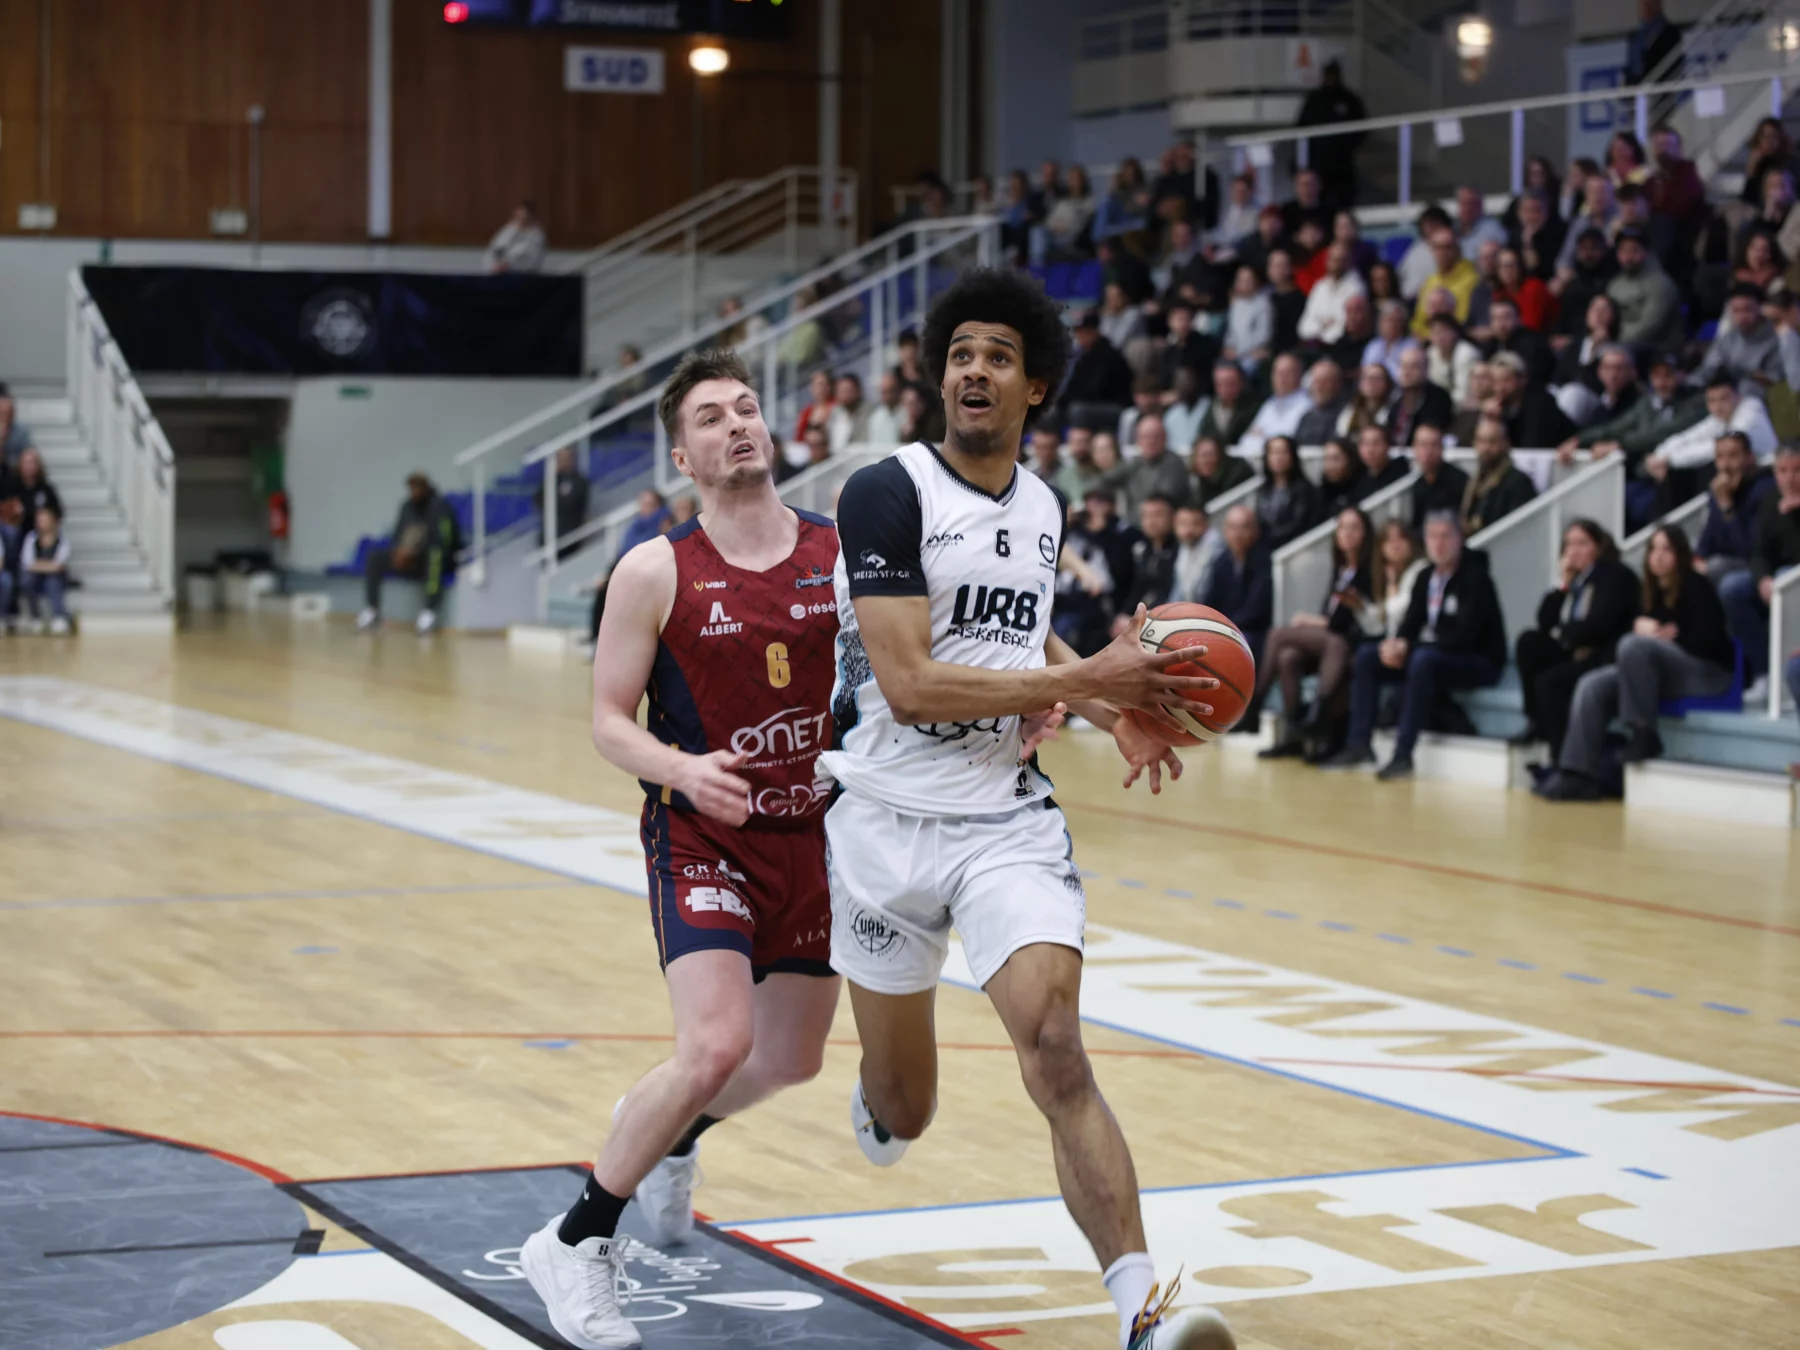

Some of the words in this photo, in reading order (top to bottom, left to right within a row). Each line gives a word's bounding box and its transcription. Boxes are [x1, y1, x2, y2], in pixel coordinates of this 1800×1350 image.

[580, 54, 650, 85] SUD
[995, 528, 1011, 559] 6
[705, 581, 727, 589] WIBO
[950, 584, 1039, 632] URB
[700, 622, 743, 637] ALBERT
[766, 642, 791, 689] 6
[740, 758, 785, 770] ROPRETÉ
